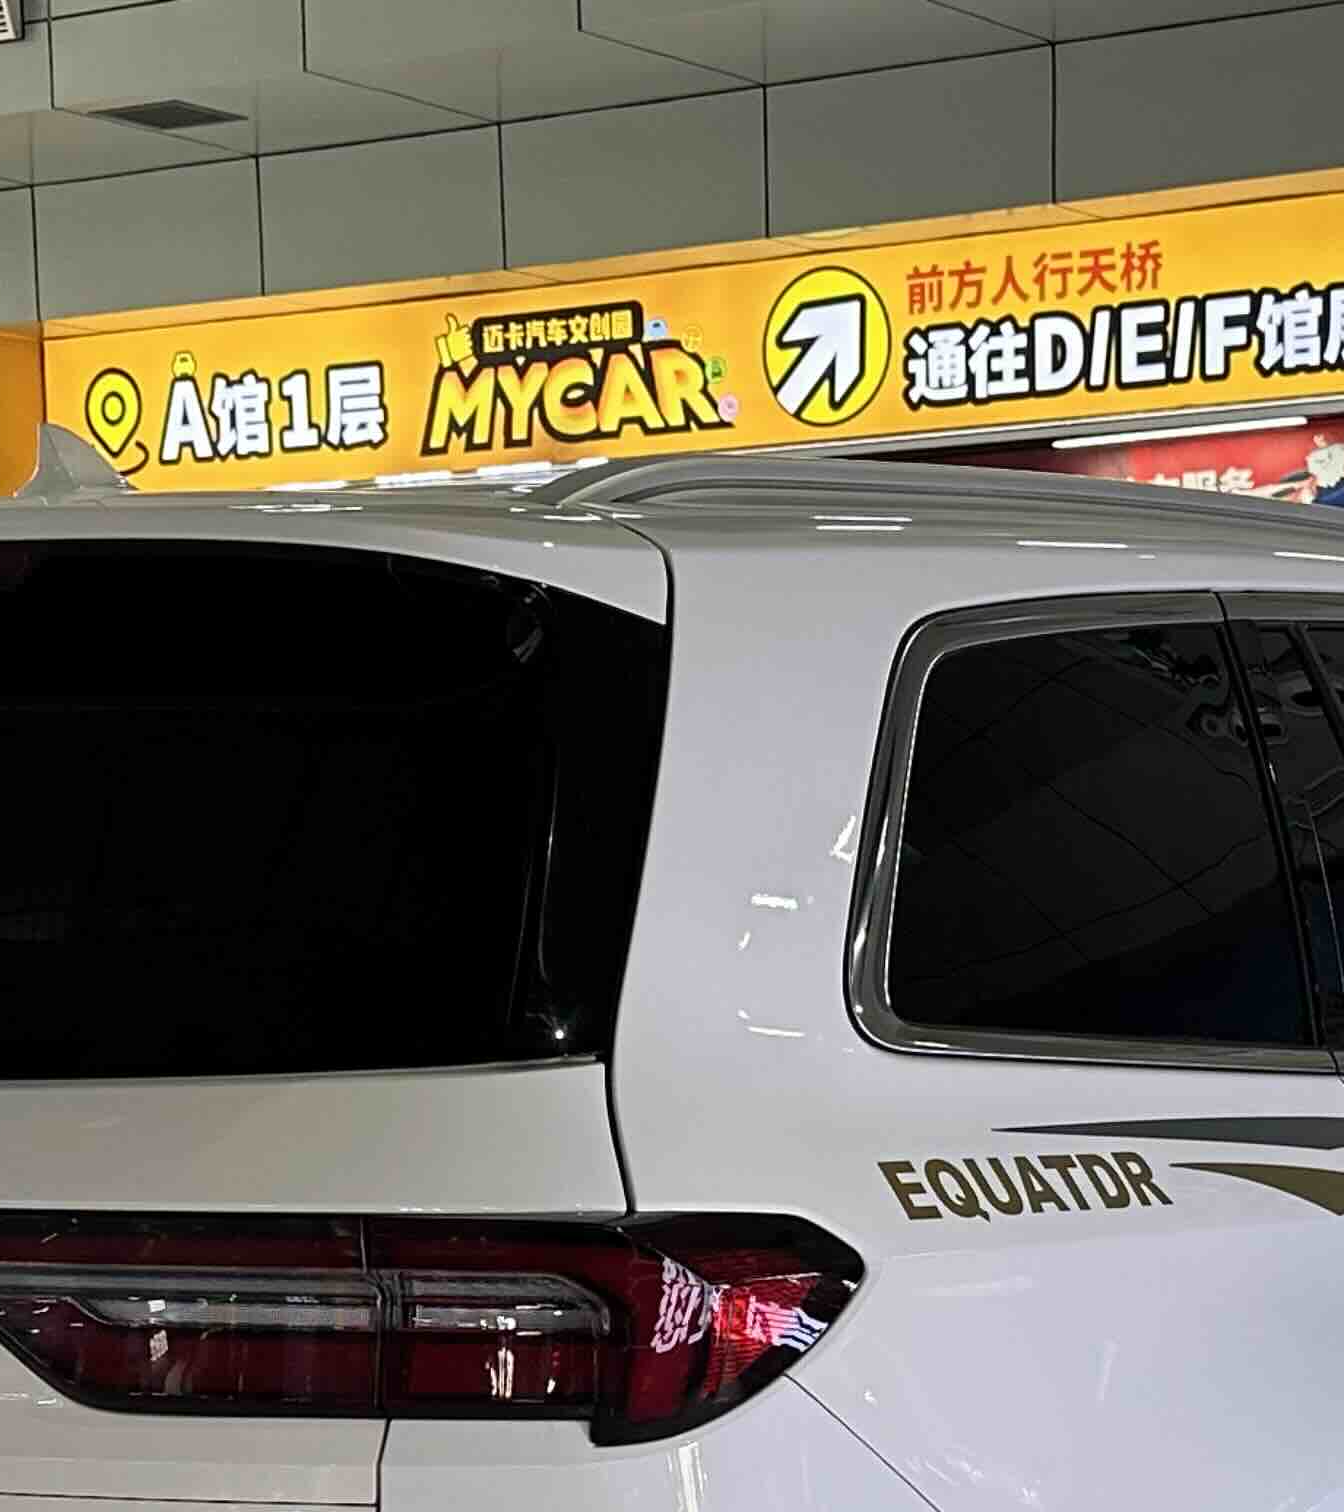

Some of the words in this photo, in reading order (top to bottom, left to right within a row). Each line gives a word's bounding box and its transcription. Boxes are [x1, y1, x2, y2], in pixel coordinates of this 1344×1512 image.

[905, 239, 1164, 316] 前方人行天桥
[482, 309, 633, 354] 迈卡汽车文创园
[158, 361, 388, 463] A馆1层
[423, 342, 726, 454] MYCAR
